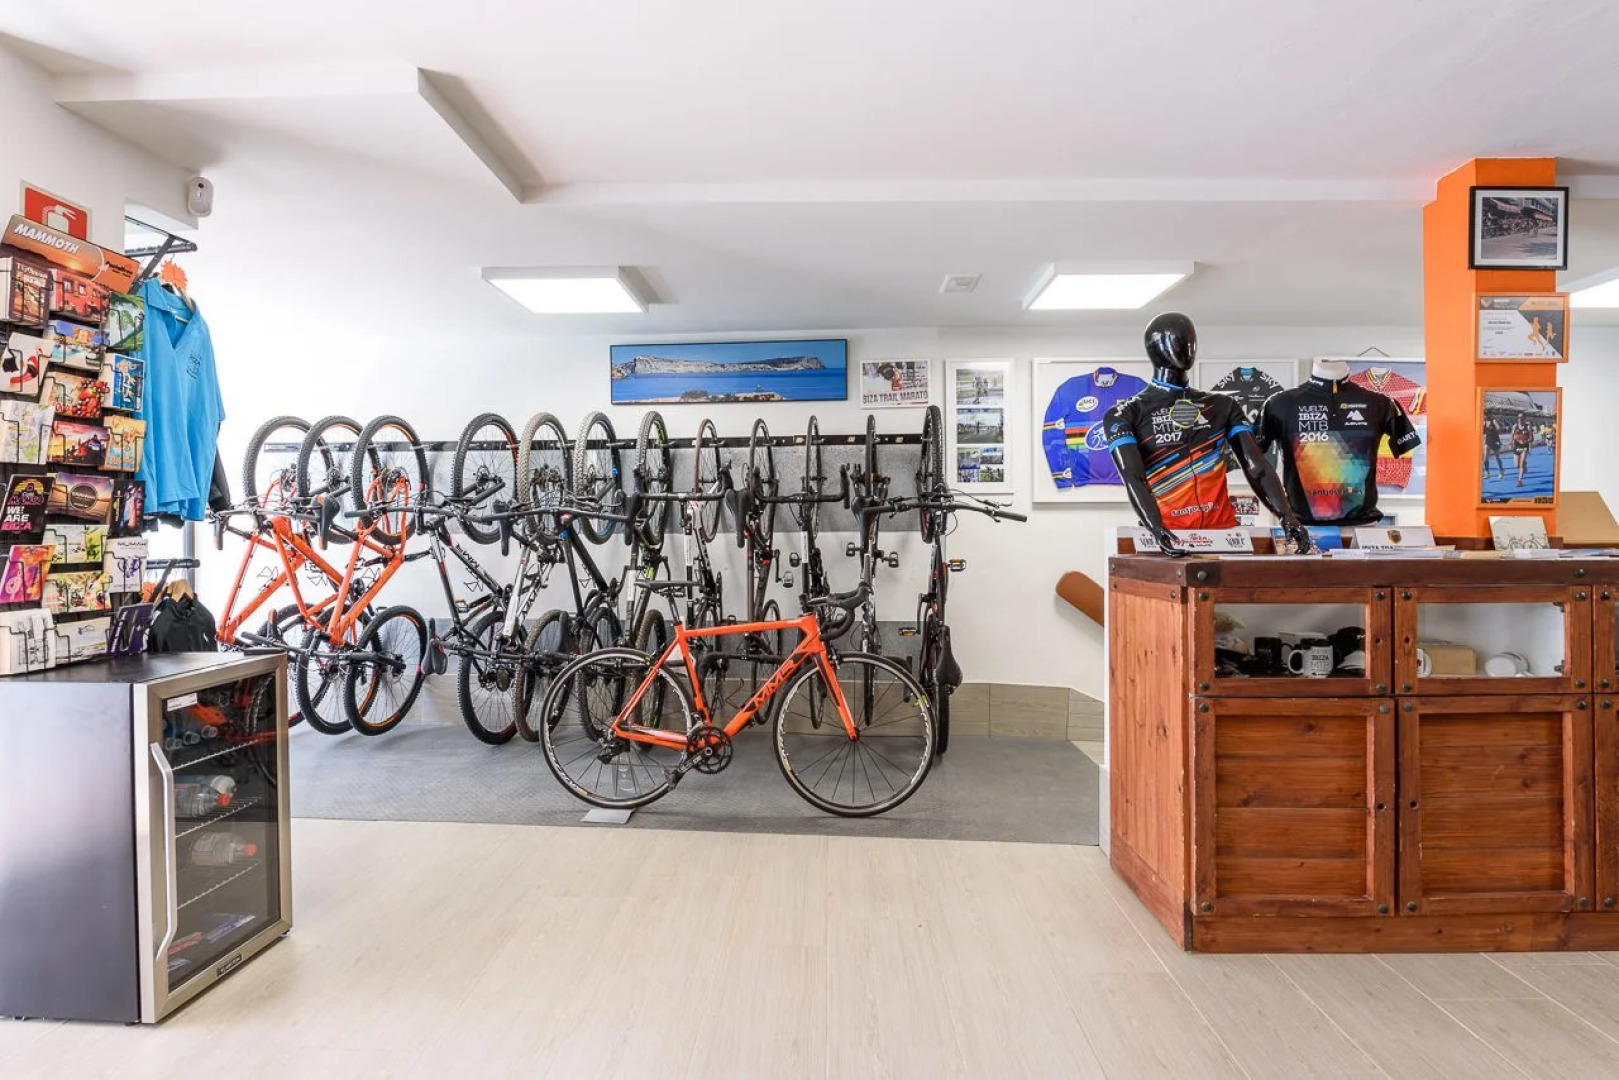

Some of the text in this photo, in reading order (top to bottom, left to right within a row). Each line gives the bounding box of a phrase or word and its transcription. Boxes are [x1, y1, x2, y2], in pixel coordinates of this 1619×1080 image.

[14, 224, 79, 254] MAMMOTH
[1217, 372, 1235, 388] SKY
[1298, 413, 1328, 421] IBIZA
[1298, 421, 1329, 432] MTB
[1155, 431, 1183, 444] 2017
[1299, 432, 1329, 442] 2016
[6, 506, 25, 514] WE
[3, 514, 30, 522] ARE
